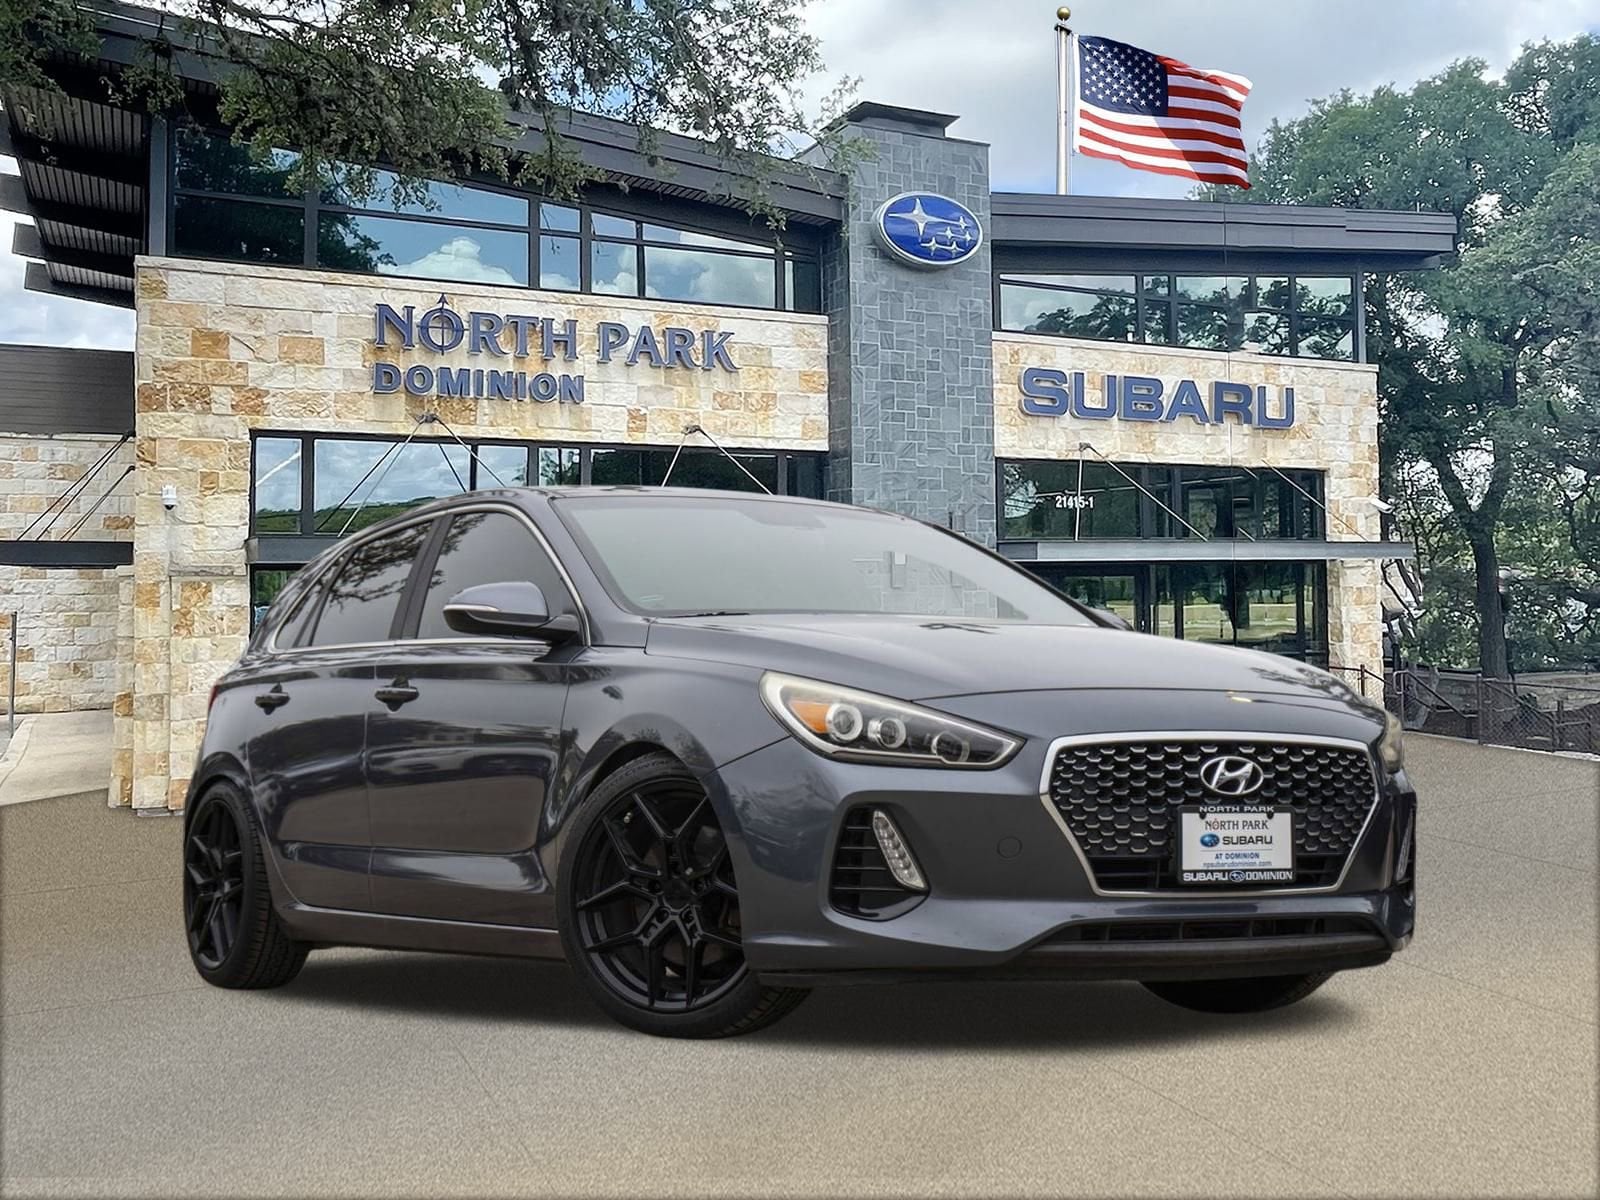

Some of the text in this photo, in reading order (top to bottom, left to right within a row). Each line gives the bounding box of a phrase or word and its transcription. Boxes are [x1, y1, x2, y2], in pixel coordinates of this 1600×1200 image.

[374, 294, 740, 373] NORTH PARK
[372, 362, 585, 403] DOMINION
[1018, 366, 1294, 430] SUBARU
[1055, 495, 1094, 509] 21415-1
[1205, 819, 1269, 831] NORTH PARK
[1222, 836, 1273, 845] SUBARU
[1225, 852, 1259, 860] DOMINION
[1183, 871, 1293, 881] SUBARU DOMINION
